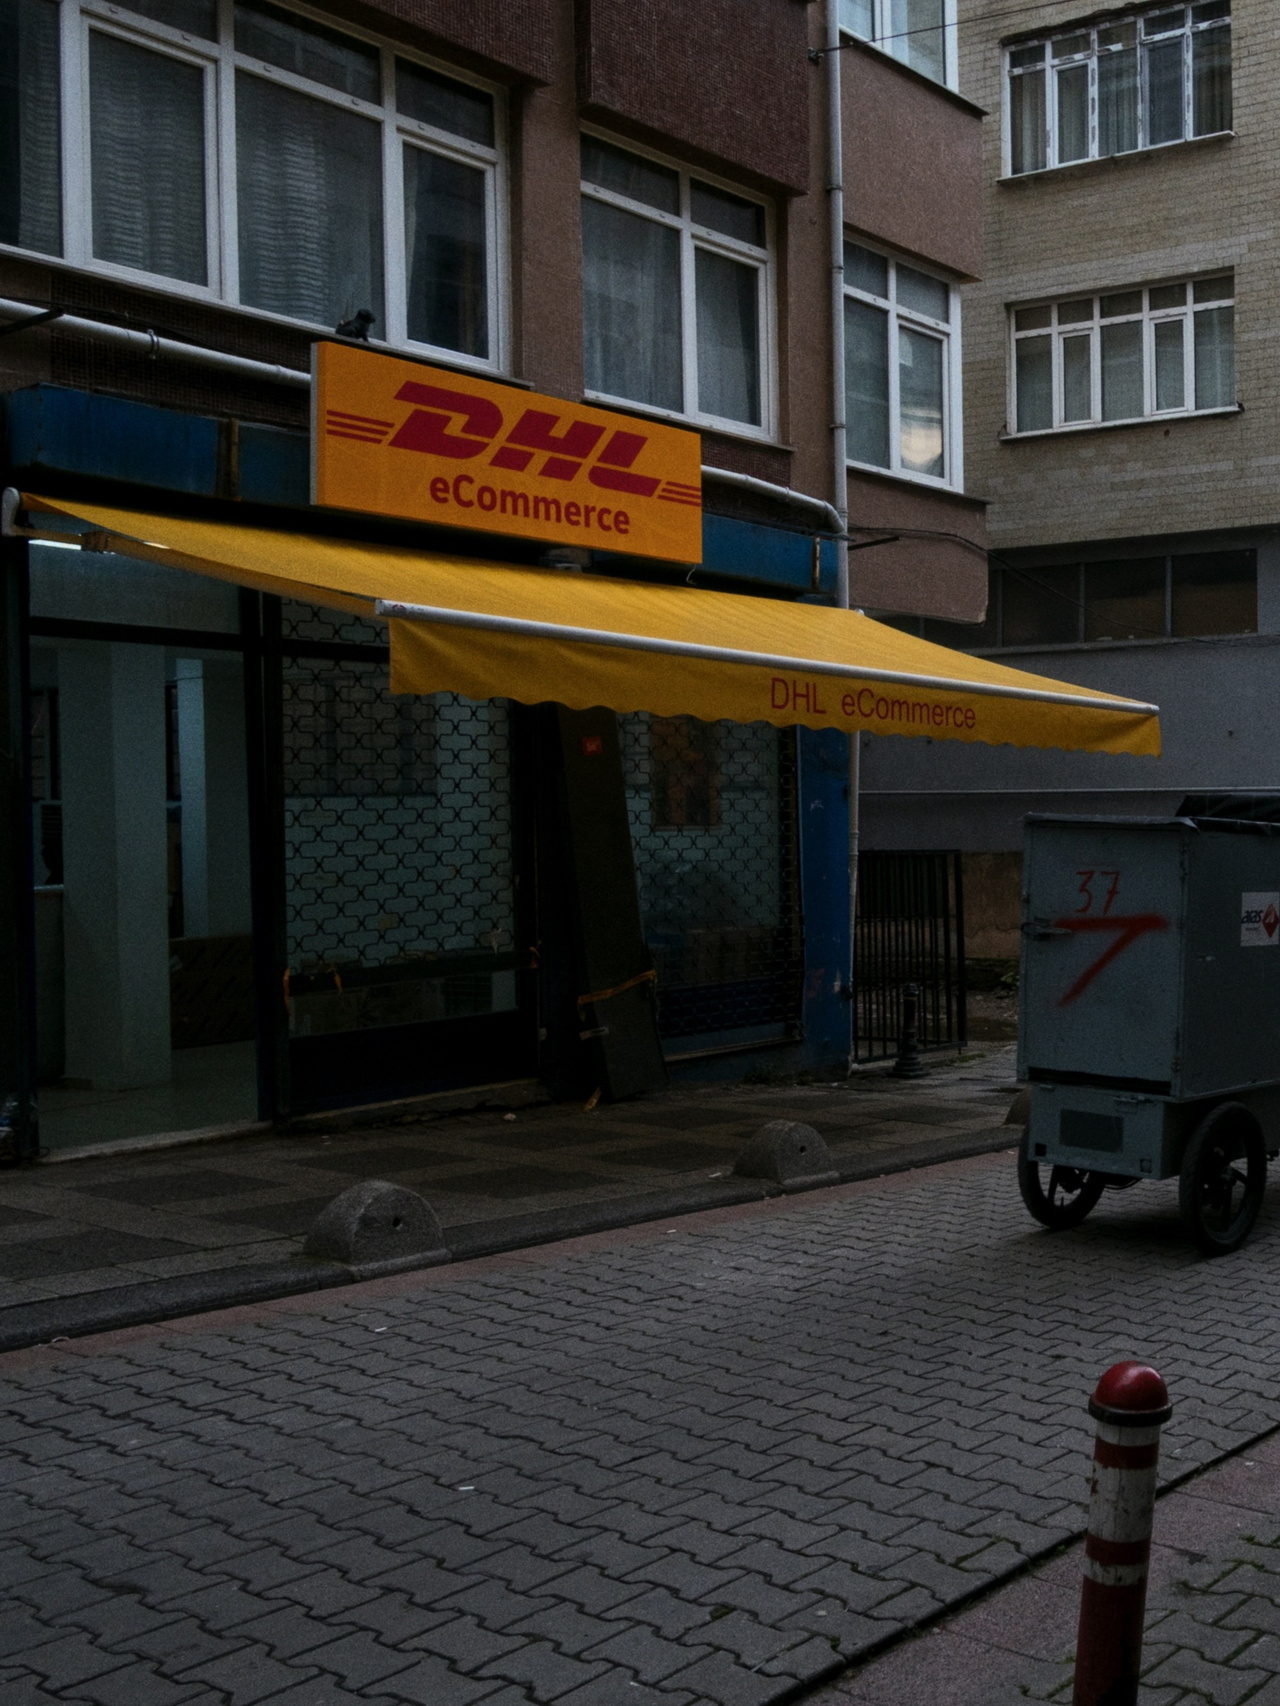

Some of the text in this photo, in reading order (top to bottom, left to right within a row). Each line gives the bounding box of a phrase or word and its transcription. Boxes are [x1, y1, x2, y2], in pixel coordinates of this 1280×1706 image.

[388, 381, 662, 497] DHL
[429, 474, 630, 534] eCommerce
[771, 677, 976, 729] DHL eCommerce
[1076, 871, 1120, 915] 37
